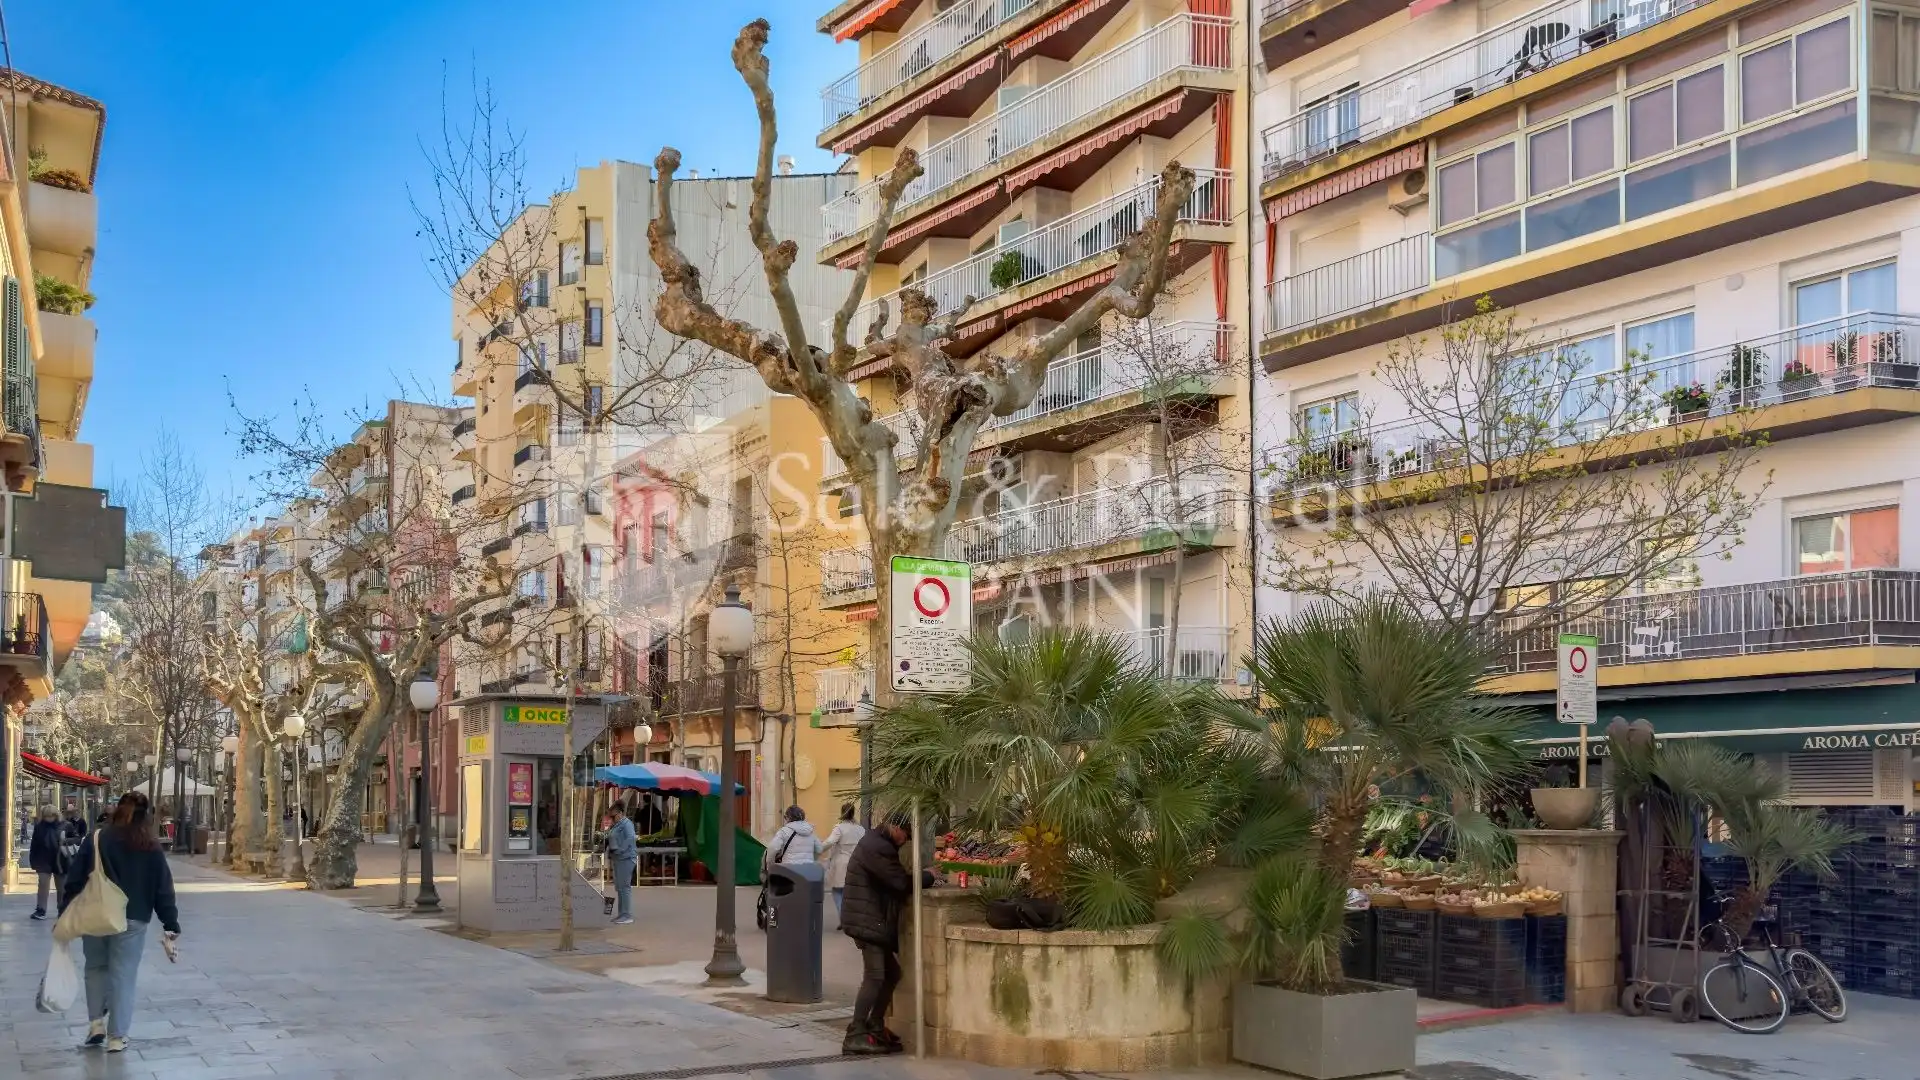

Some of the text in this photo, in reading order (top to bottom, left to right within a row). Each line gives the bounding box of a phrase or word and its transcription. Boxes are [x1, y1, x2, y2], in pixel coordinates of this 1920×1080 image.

[524, 709, 567, 722] ONCE
[1803, 730, 1920, 749] AROMA CAFÉ
[1592, 744, 1611, 756] CA
